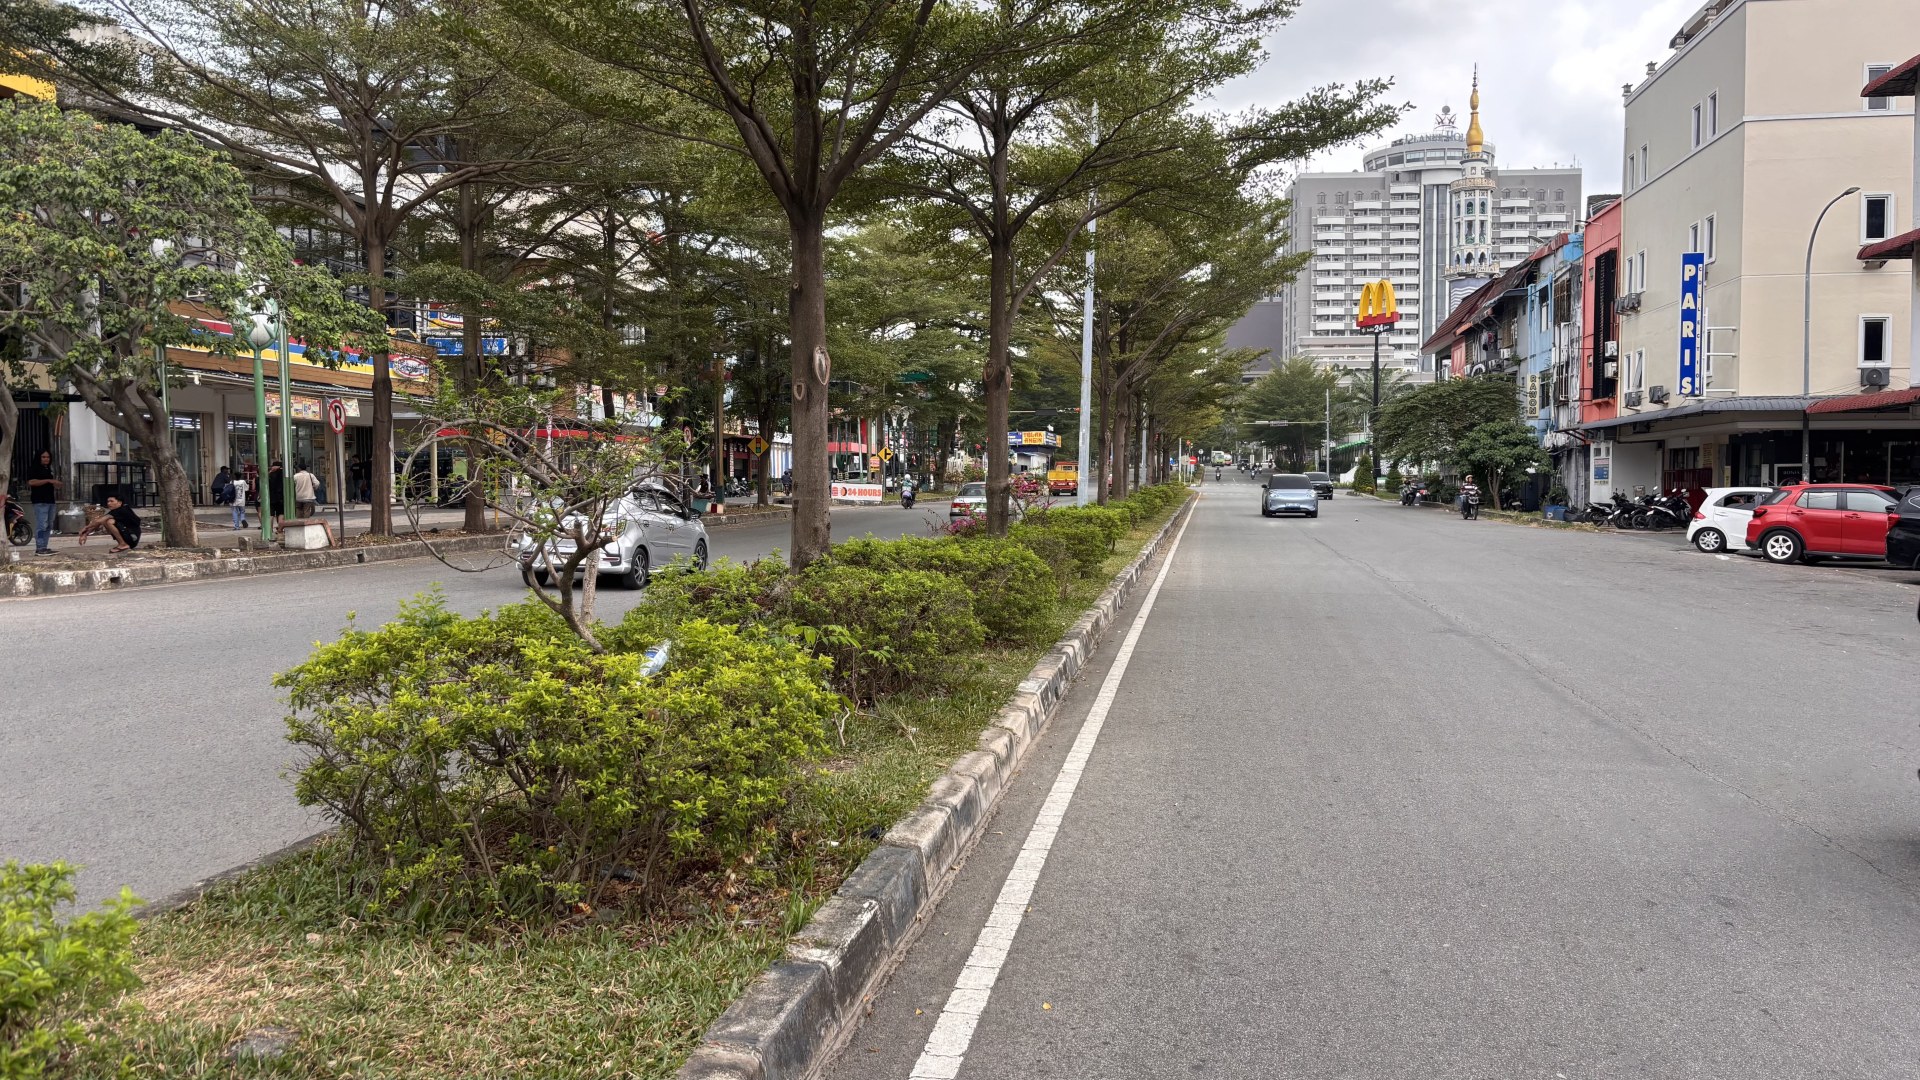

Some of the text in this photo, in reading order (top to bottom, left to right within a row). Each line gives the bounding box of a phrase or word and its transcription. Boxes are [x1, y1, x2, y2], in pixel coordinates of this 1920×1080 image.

[1374, 324, 1383, 332] 24
[1681, 264, 1696, 394] PARIS
[1529, 374, 1537, 414] RAWON
[334, 404, 342, 428] P
[848, 488, 857, 496] 24
[858, 488, 881, 497] HOURS
